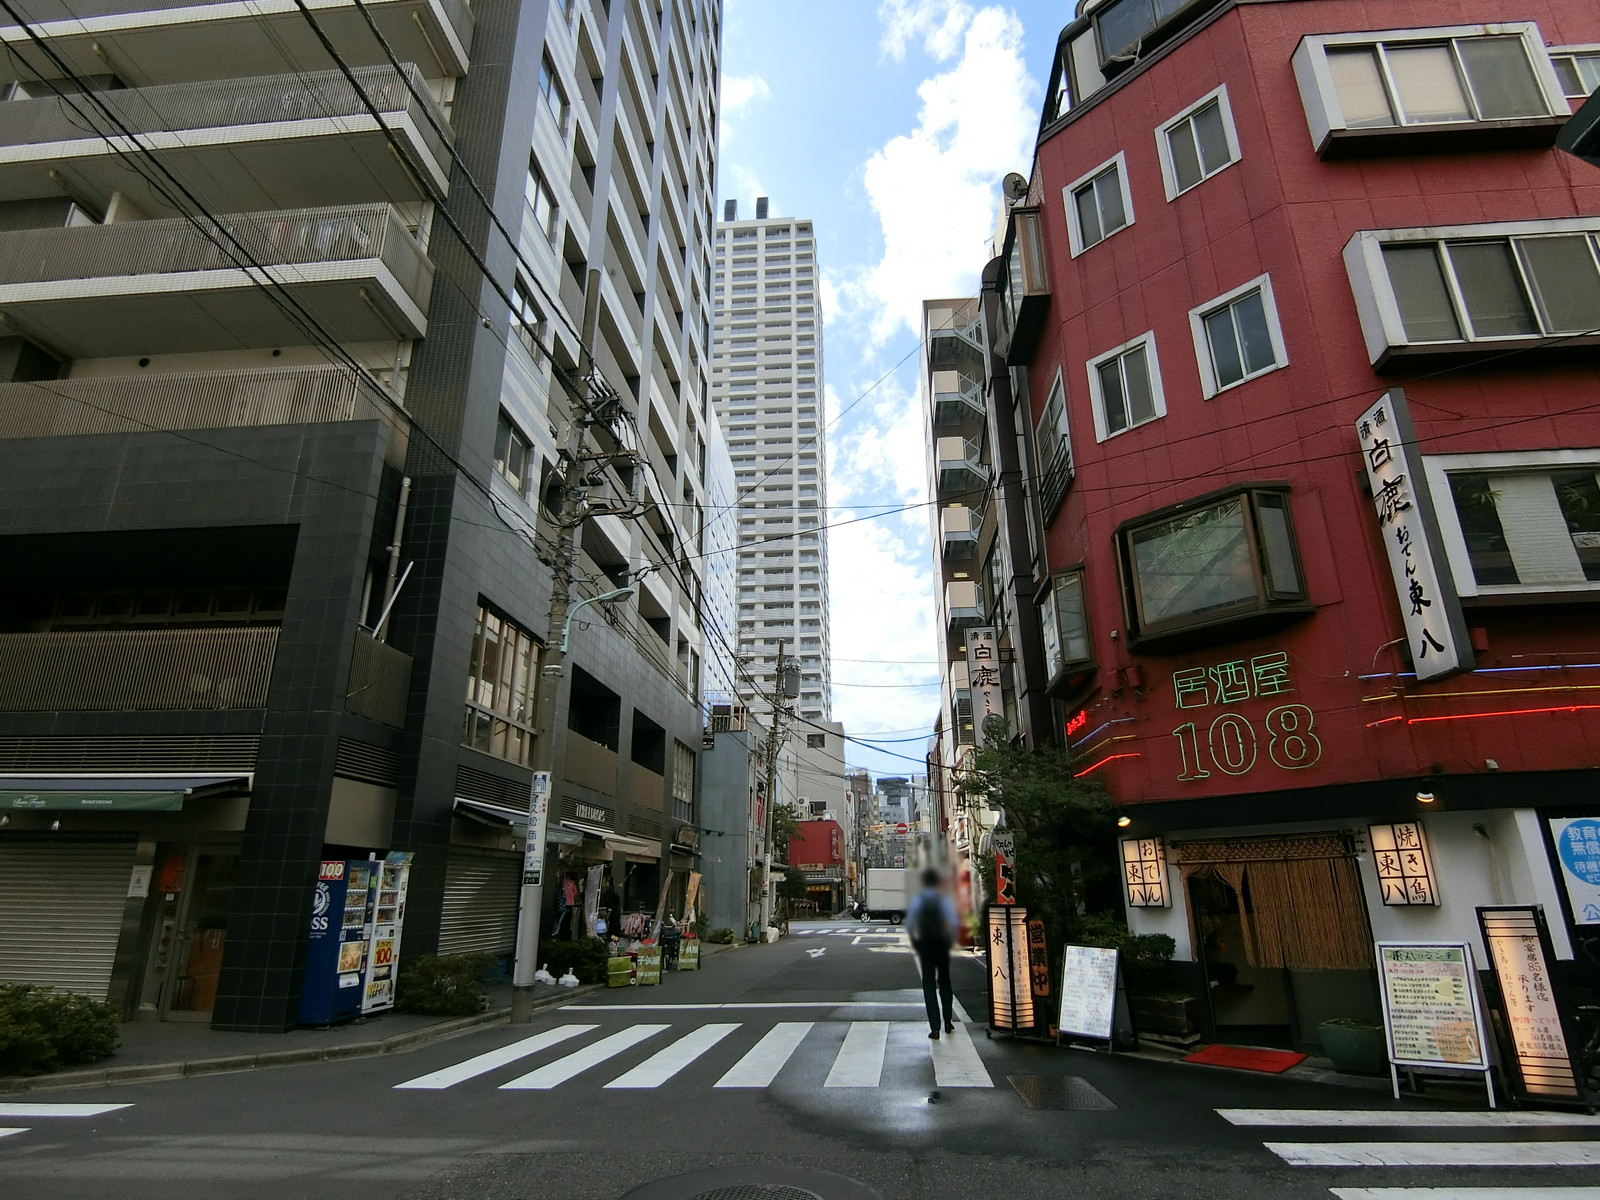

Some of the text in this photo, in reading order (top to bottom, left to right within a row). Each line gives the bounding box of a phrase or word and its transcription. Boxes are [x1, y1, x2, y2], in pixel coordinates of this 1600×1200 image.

[1359, 406, 1387, 440] 清酒
[1368, 438, 1413, 528] 白鹿
[1395, 526, 1416, 578] おでん
[1410, 578, 1445, 659] 東八
[971, 643, 1000, 687] 白鹿
[1172, 651, 1295, 709] 居酒屋
[1172, 703, 1322, 782] 108
[1567, 826, 1600, 841] 教育
[1128, 863, 1146, 904] 東八
[1142, 841, 1161, 903] おでん
[1379, 852, 1406, 902] 東八
[1397, 825, 1427, 903] 焼き鳥
[375, 947, 392, 965] 100
[992, 926, 1007, 980] 東八
[1030, 922, 1048, 991] 営業中
